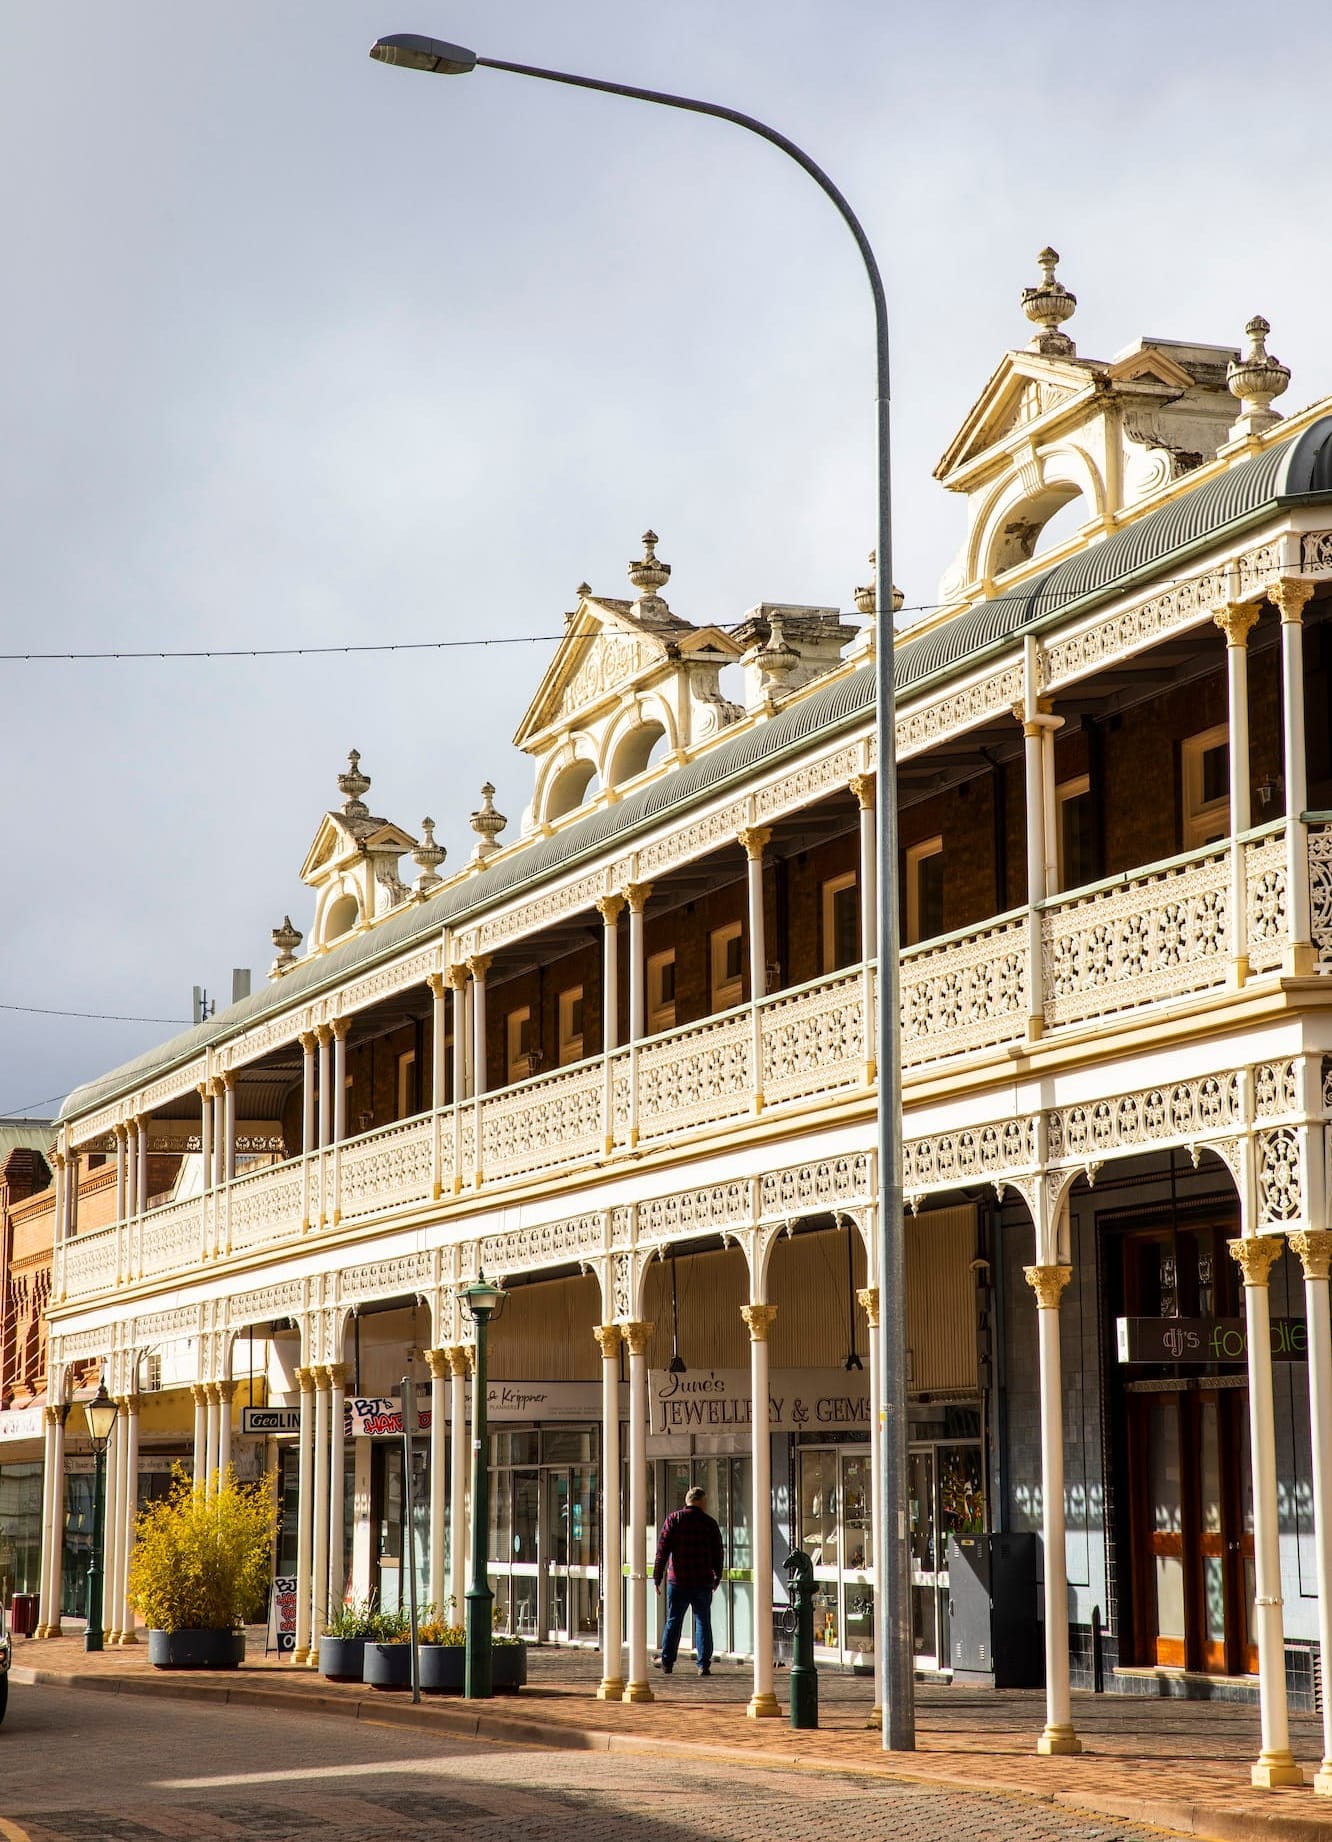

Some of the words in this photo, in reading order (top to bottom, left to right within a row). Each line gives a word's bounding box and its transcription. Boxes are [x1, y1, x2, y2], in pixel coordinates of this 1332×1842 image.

[1162, 1327, 1200, 1358] dj's
[1207, 1320, 1308, 1358] fodie
[502, 1387, 549, 1411] Krippner
[658, 1371, 726, 1398] June's
[659, 1399, 784, 1433] JEWELLEY
[791, 1398, 809, 1423] &
